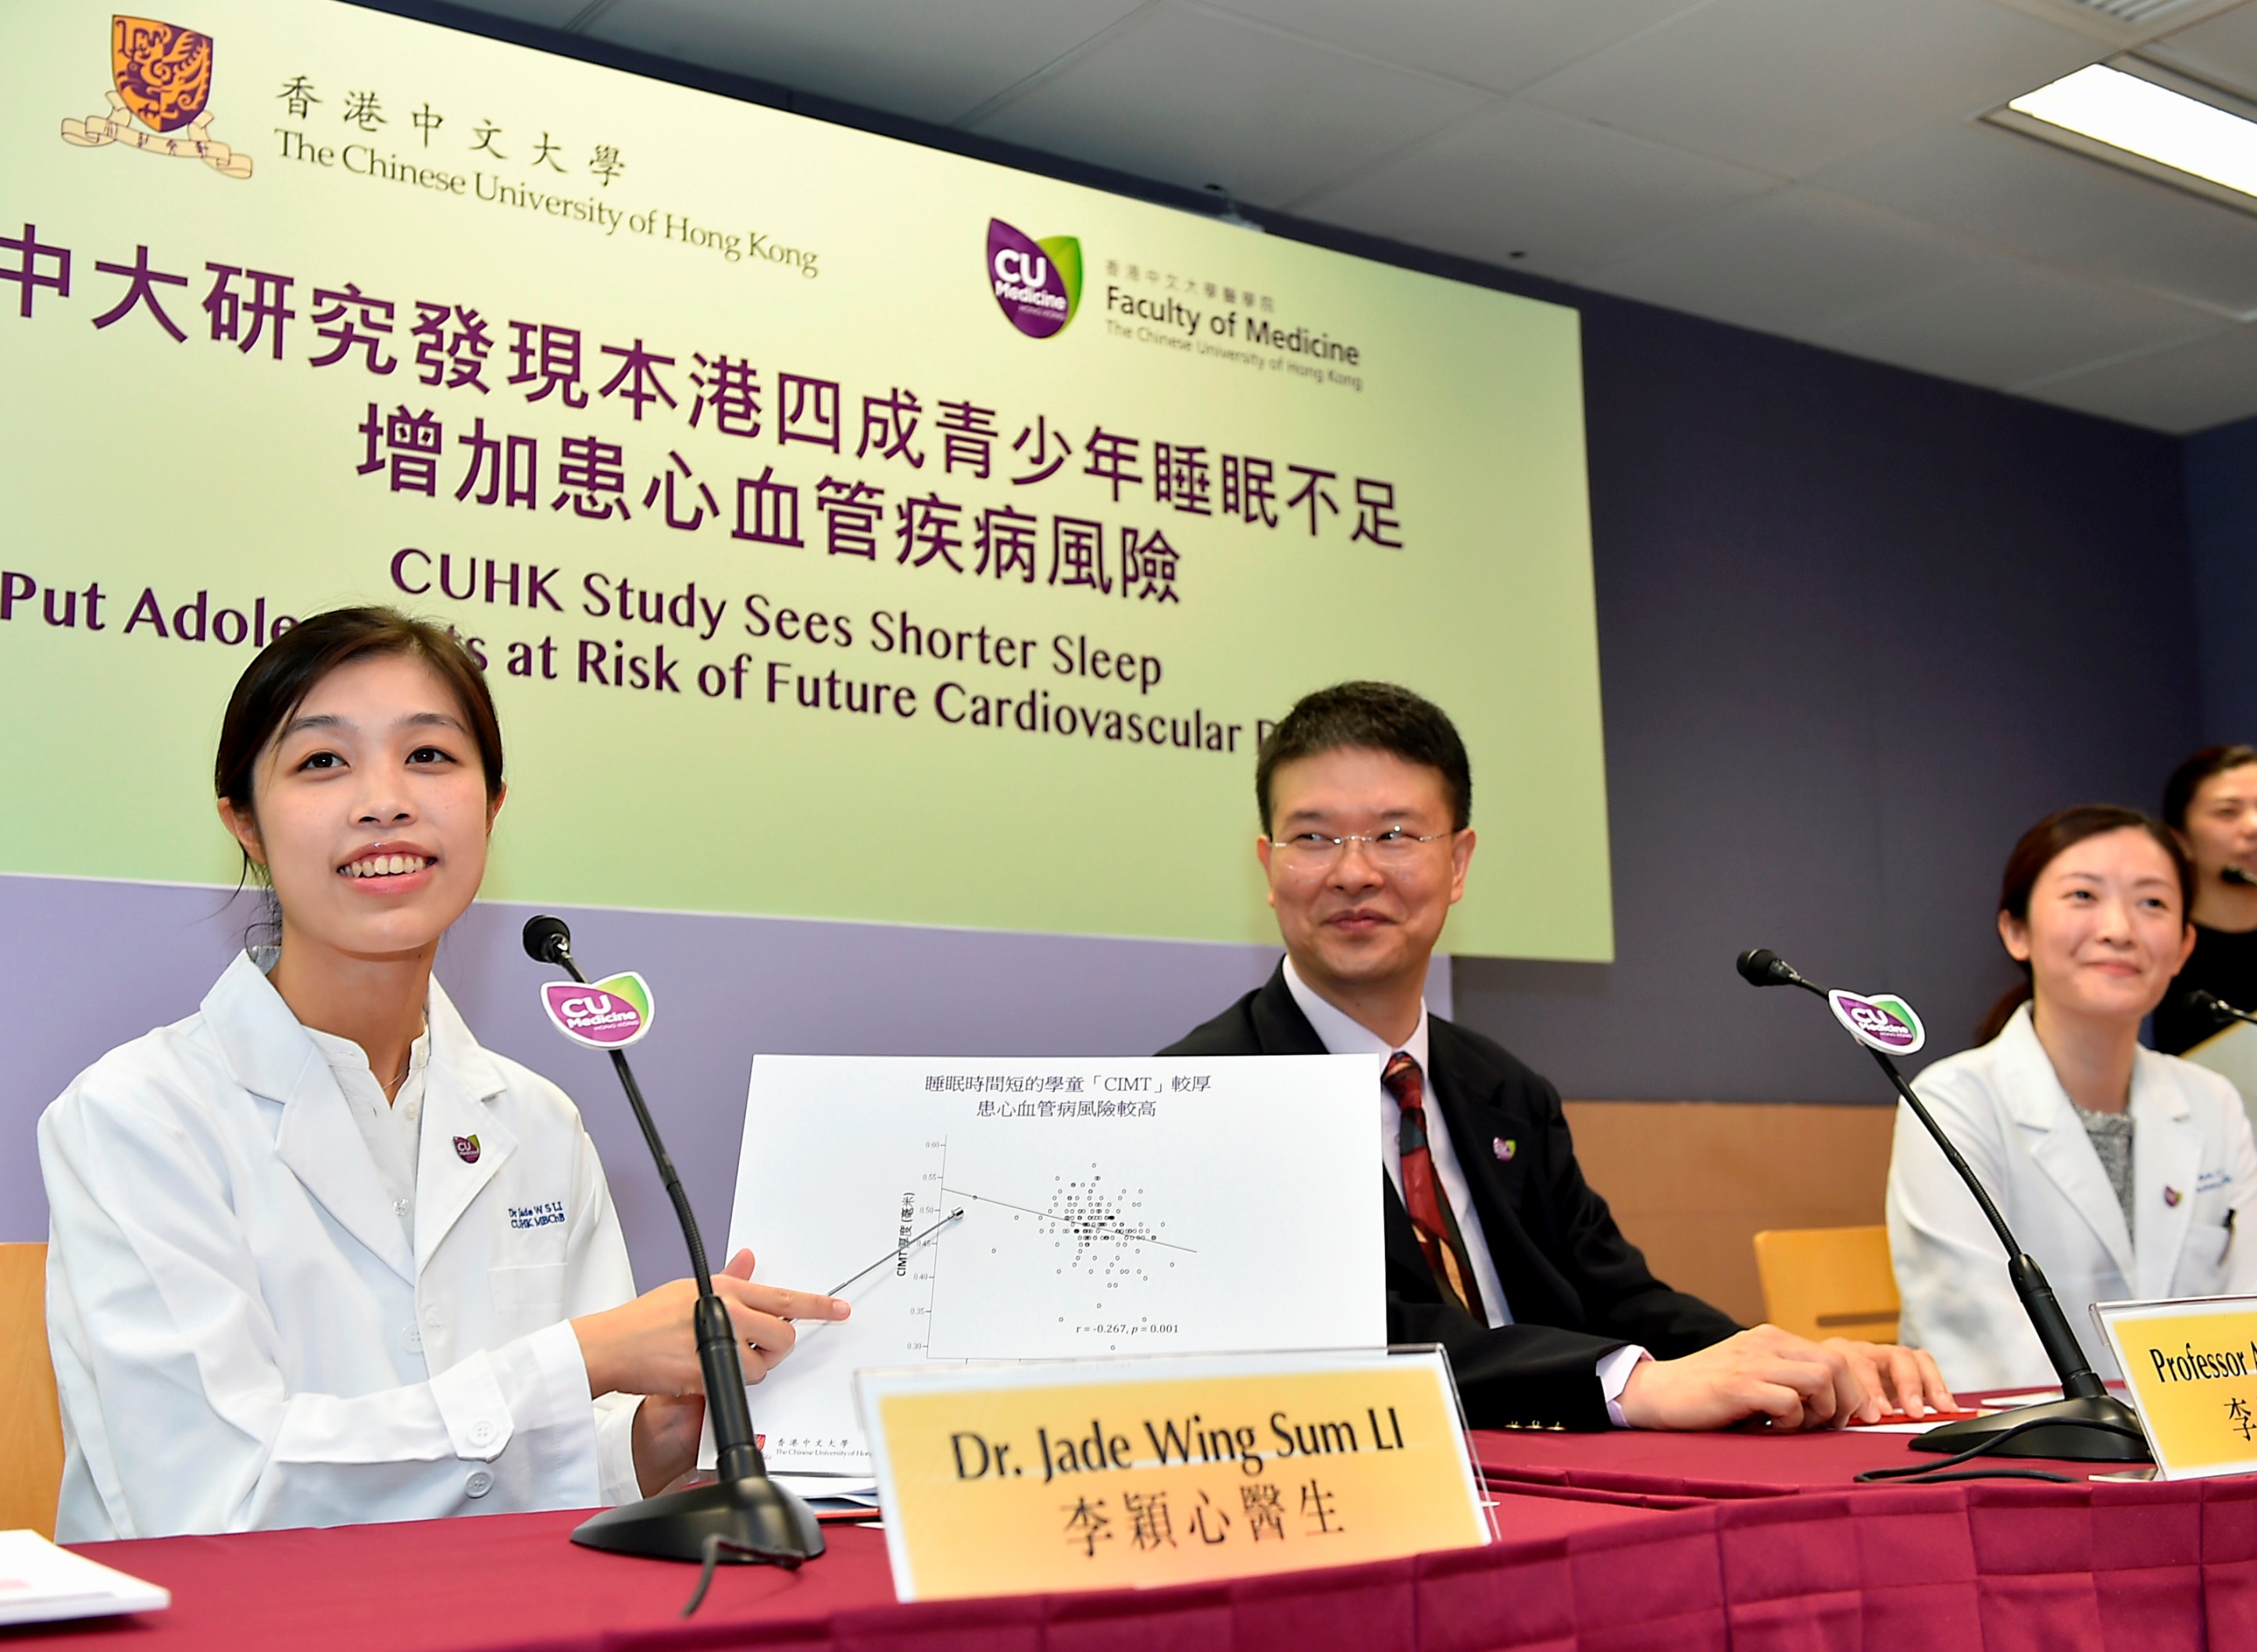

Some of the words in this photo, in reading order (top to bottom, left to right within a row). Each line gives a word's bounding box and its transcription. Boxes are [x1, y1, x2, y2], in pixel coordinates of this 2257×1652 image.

[275, 75, 627, 187] 香港中文大學
[273, 127, 335, 166] The
[341, 144, 466, 194] Chinese
[474, 173, 623, 236] University
[629, 209, 659, 236] of
[665, 213, 741, 262] Hong
[749, 231, 819, 278] Kong
[995, 248, 1047, 287] CU
[995, 280, 1067, 312] Medicine
[1107, 285, 1201, 336] Faculty
[1210, 312, 1236, 337] of
[1245, 316, 1360, 366] Medicine
[1105, 319, 1133, 338] The
[1137, 326, 1191, 352] Chinese
[1197, 340, 1266, 370] University
[1269, 355, 1284, 370] of
[1287, 362, 1324, 384] Hong
[1327, 369, 1362, 391] Kong
[0, 223, 1404, 550] 中大研究發現本港四成青少年睡眠不足
[356, 402, 1180, 604] 增加患心血管疾病風險
[390, 548, 564, 612] CUHK
[582, 572, 726, 640] Study
[745, 594, 853, 647] Sees
[870, 610, 1037, 670] Shorter
[1052, 633, 1162, 693] Sleep
[0, 570, 106, 630] Put
[507, 635, 557, 680] at
[577, 638, 681, 693] Risk
[697, 652, 752, 701] of
[766, 661, 916, 717] Future
[935, 682, 1242, 753] Cardiovascular
[561, 994, 612, 1018] CU
[566, 1012, 637, 1029] Medicine
[1851, 1008, 1888, 1025] CU
[1858, 1022, 1909, 1033] Medicine
[977, 1100, 1156, 1118] 患心血管病風險較高
[457, 1141, 472, 1151] CU
[511, 1218, 534, 1229] CUHK
[534, 1205, 543, 1214] W
[545, 1204, 552, 1212] S
[897, 1251, 908, 1276] CIMT
[1093, 1324, 1128, 1334] -0.267,
[1130, 1326, 1138, 1335] p
[1150, 1324, 1178, 1333] 0.001
[2149, 1343, 2248, 1383] Professor
[777, 1438, 849, 1449] 香港中文大學
[788, 1448, 814, 1457] Chinese
[951, 1431, 1022, 1480] Dr.
[1037, 1419, 1132, 1484] Jade
[1143, 1414, 1263, 1476] Wing
[1270, 1411, 1359, 1459] Sum
[1367, 1407, 1405, 1450] LI
[1059, 1478, 1345, 1558] 李穎心醫生
